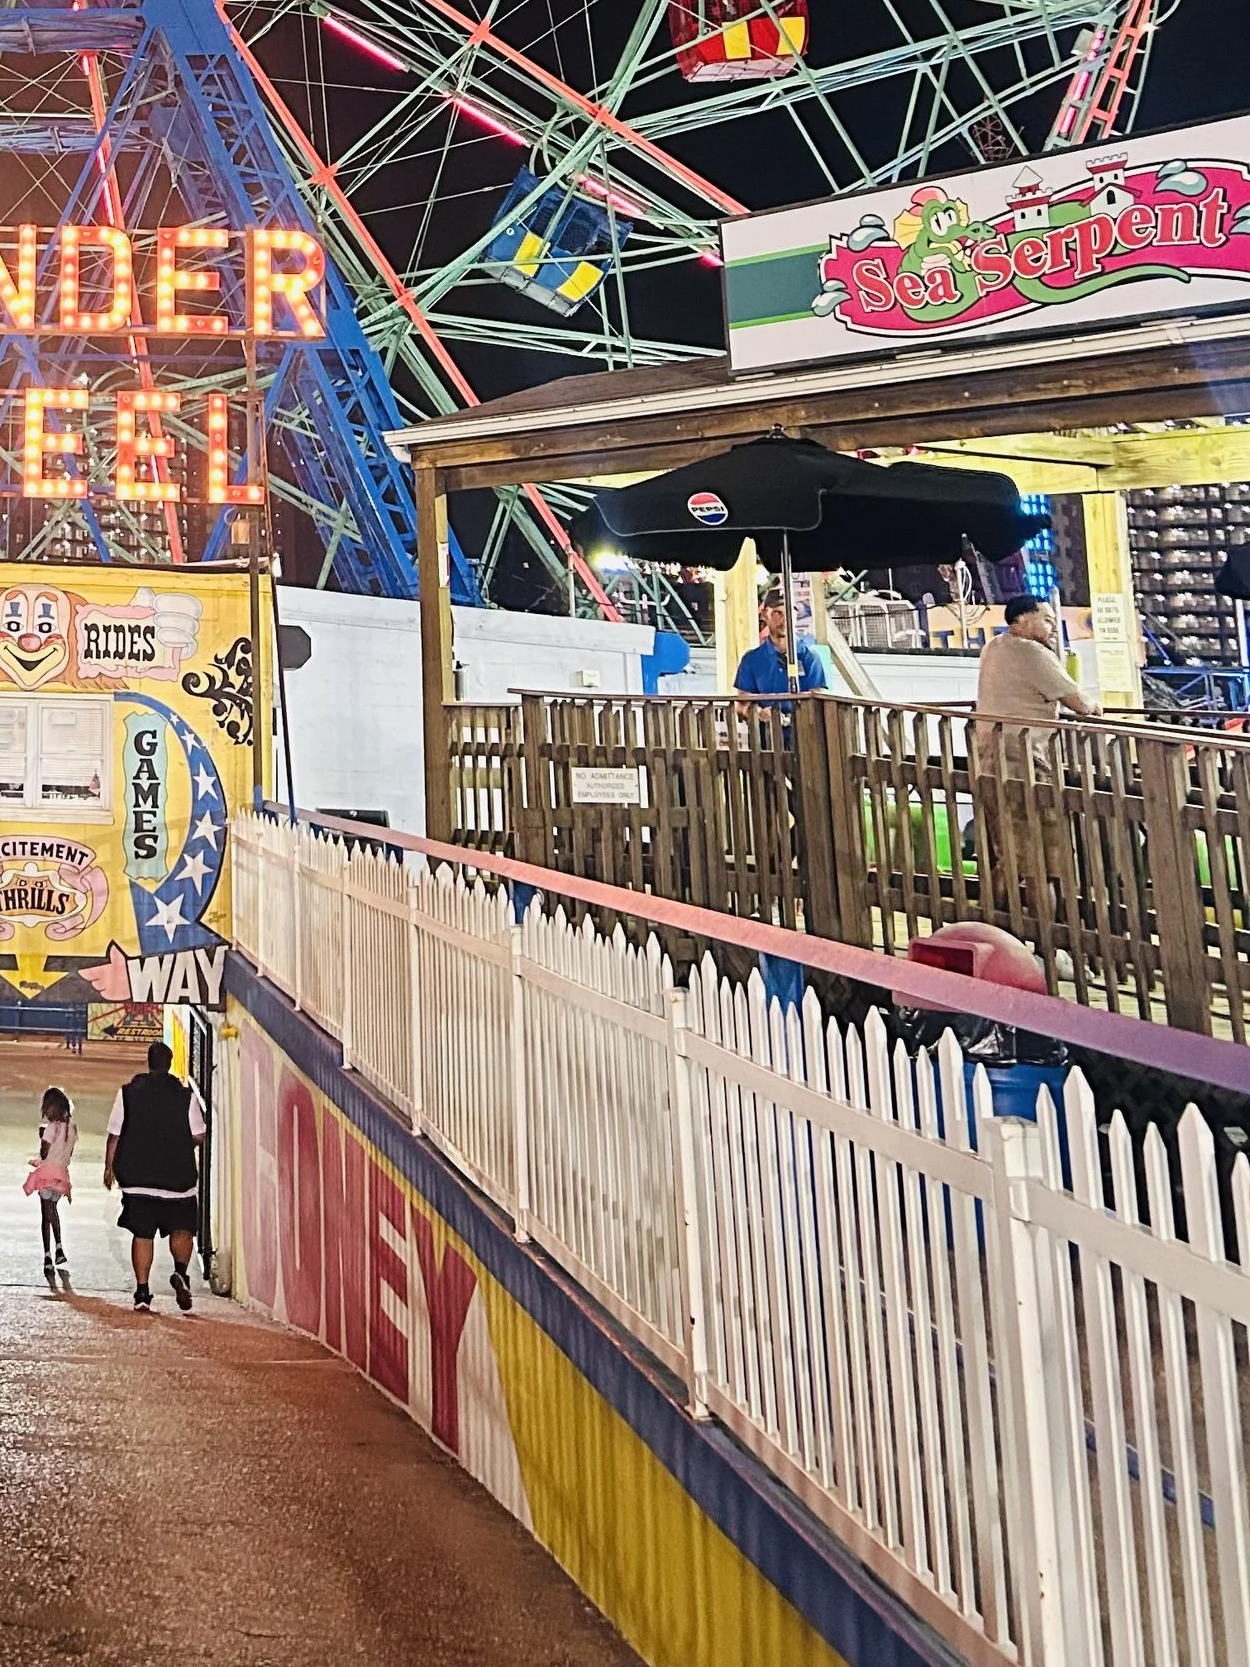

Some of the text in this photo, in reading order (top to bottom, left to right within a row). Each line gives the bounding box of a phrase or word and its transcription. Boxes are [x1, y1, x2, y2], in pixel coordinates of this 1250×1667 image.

[852, 186, 1230, 314] Sea Serpent
[83, 623, 156, 662] RIDES
[133, 730, 159, 860] GAMES
[575, 772, 634, 780] NO ADMITTANCE
[578, 791, 615, 799] EMPLOYEES
[586, 782, 625, 790] AUTHORIZED
[127, 944, 229, 1004] WAY
[238, 1017, 479, 1455] CONEY
